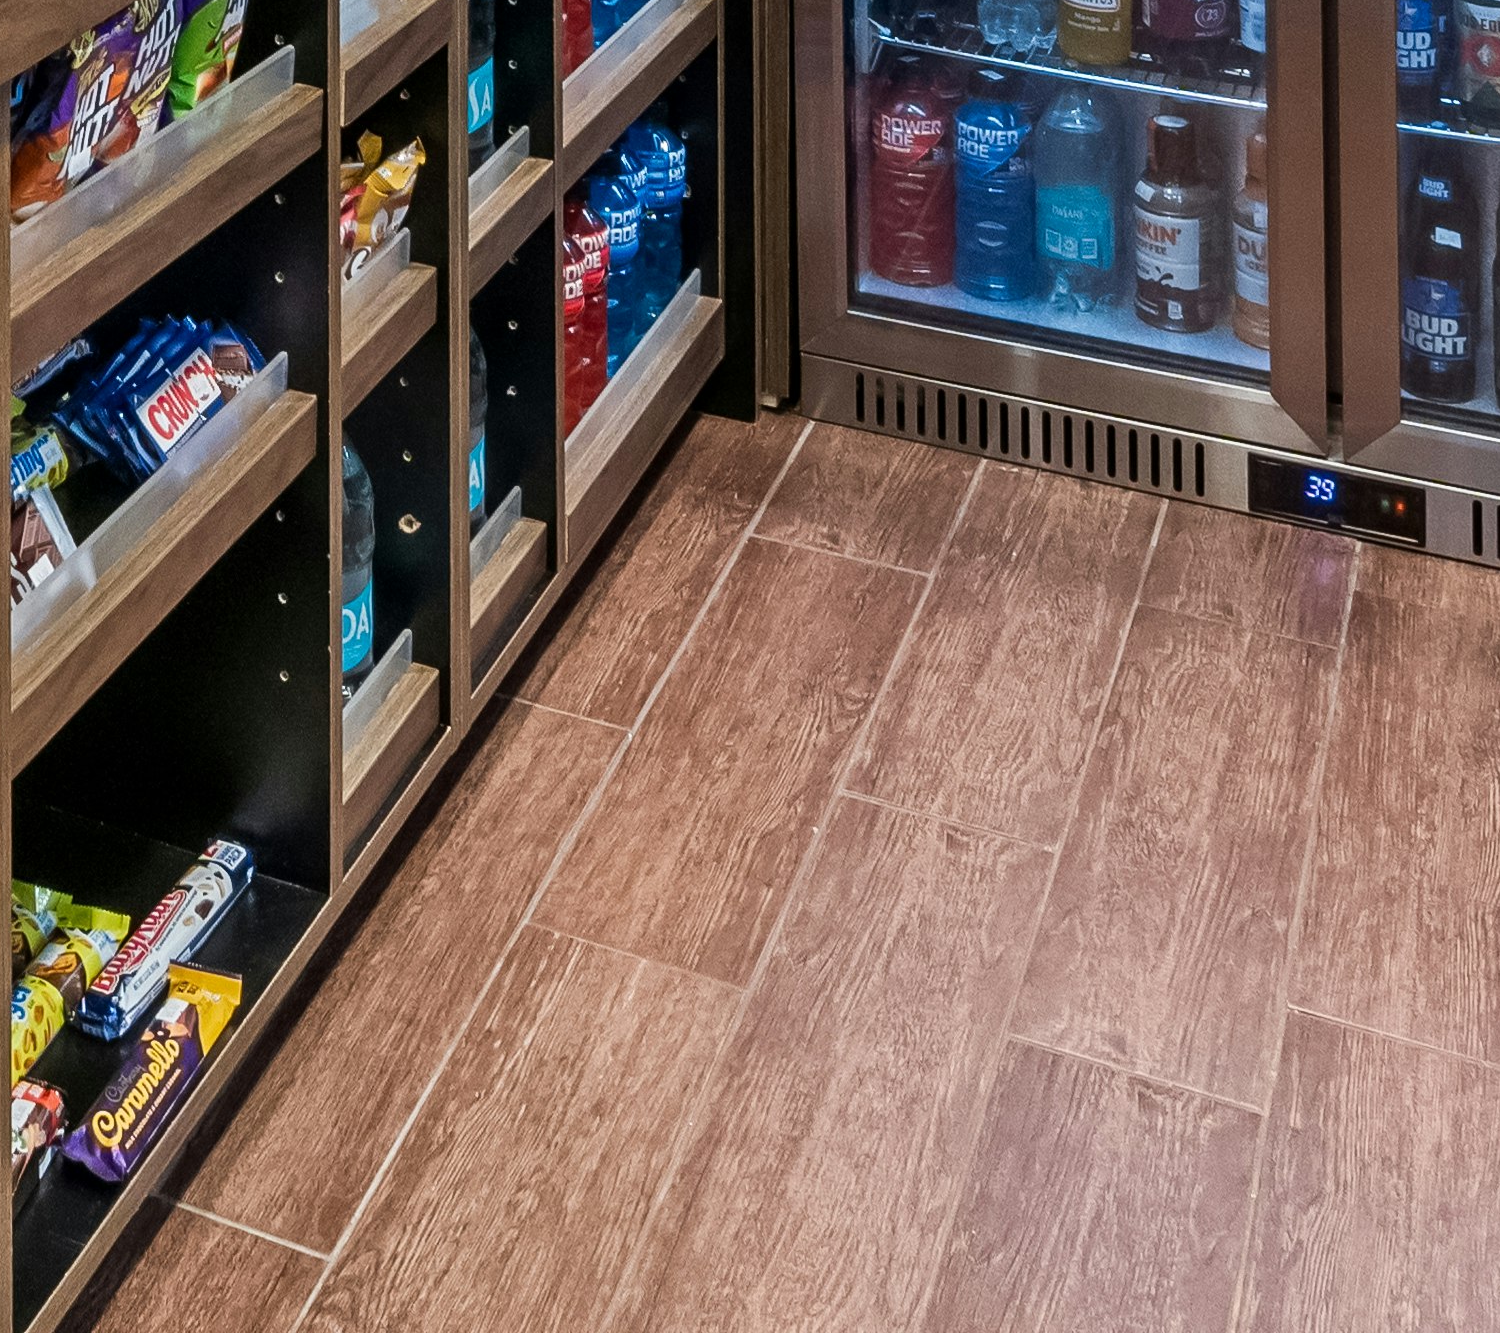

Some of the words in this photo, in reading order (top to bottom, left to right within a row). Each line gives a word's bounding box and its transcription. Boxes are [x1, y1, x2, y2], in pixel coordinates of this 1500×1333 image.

[881, 114, 942, 136] POWER
[957, 120, 1019, 146] POWER
[1419, 185, 1449, 201] LIGHT
[1422, 178, 1446, 190] BUD
[1405, 312, 1460, 336] BUD
[1305, 475, 1335, 501] 39
[92, 1037, 181, 1150] Caramello
